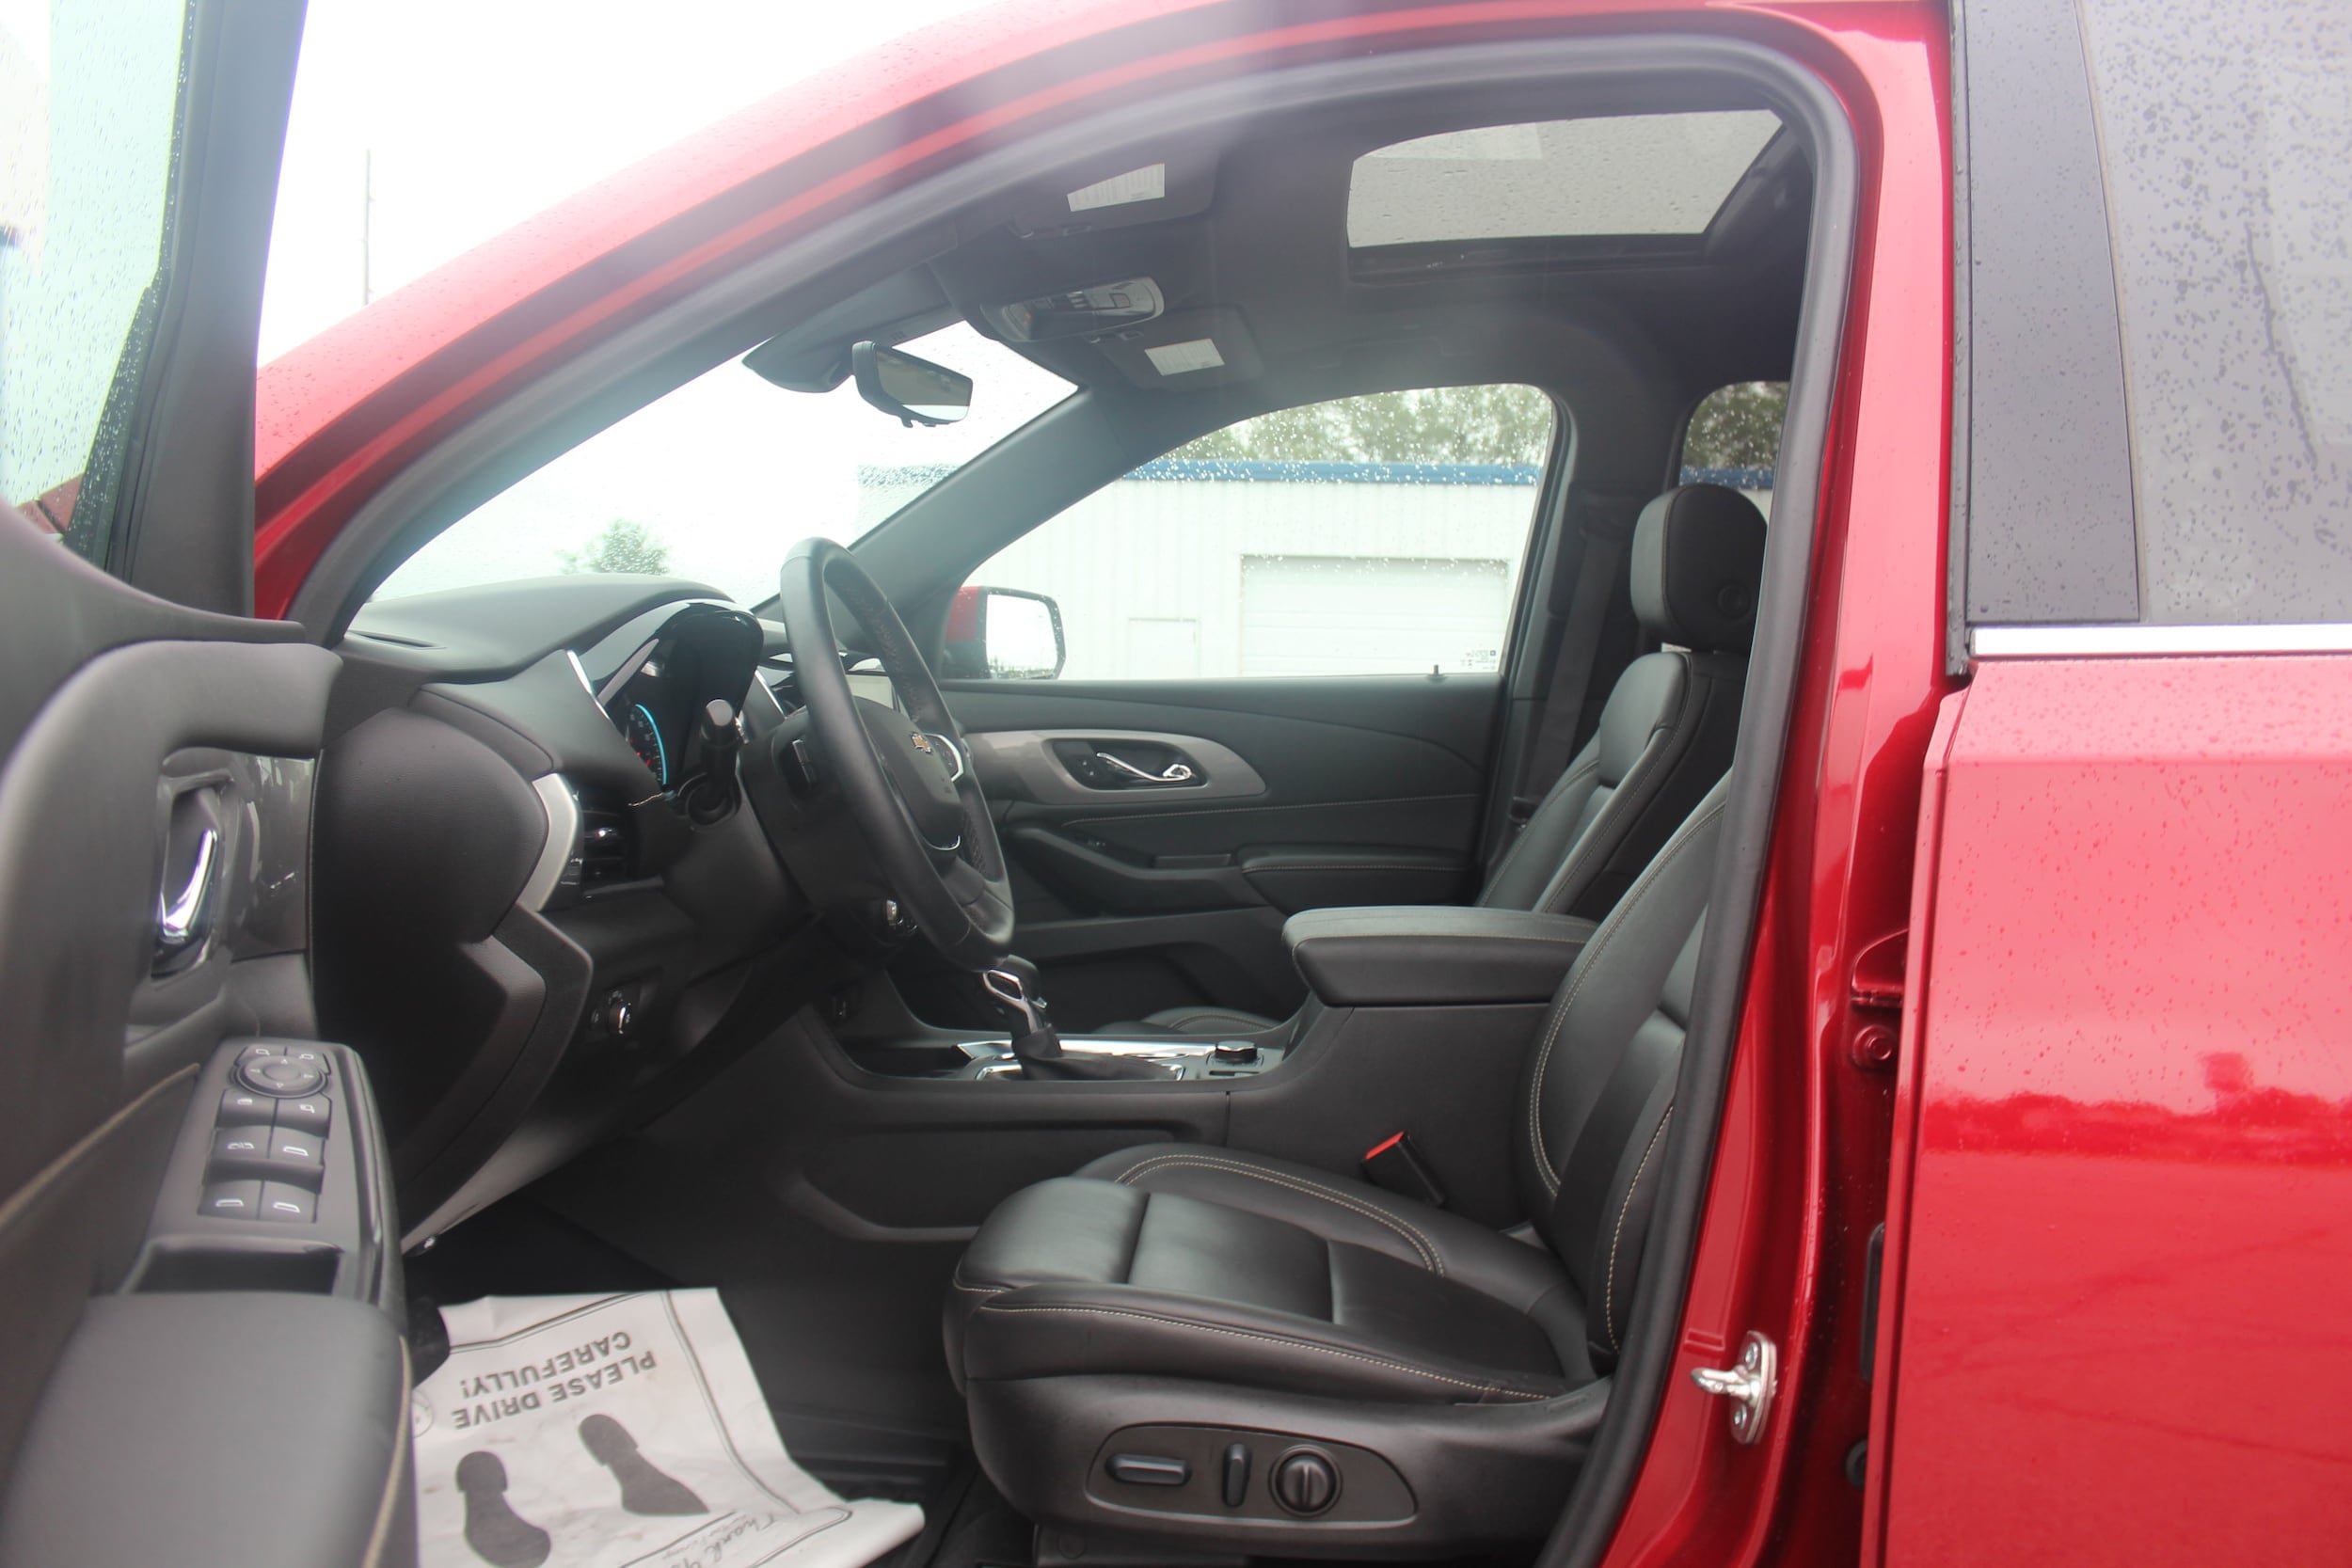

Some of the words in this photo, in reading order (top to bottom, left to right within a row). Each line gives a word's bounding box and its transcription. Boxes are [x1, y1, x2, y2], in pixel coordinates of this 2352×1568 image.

[460, 1331, 631, 1399] CAREFULLY!
[548, 1351, 658, 1403] PLEASE
[452, 1391, 541, 1430] DRIVE
[703, 1513, 777, 1563] Thank
